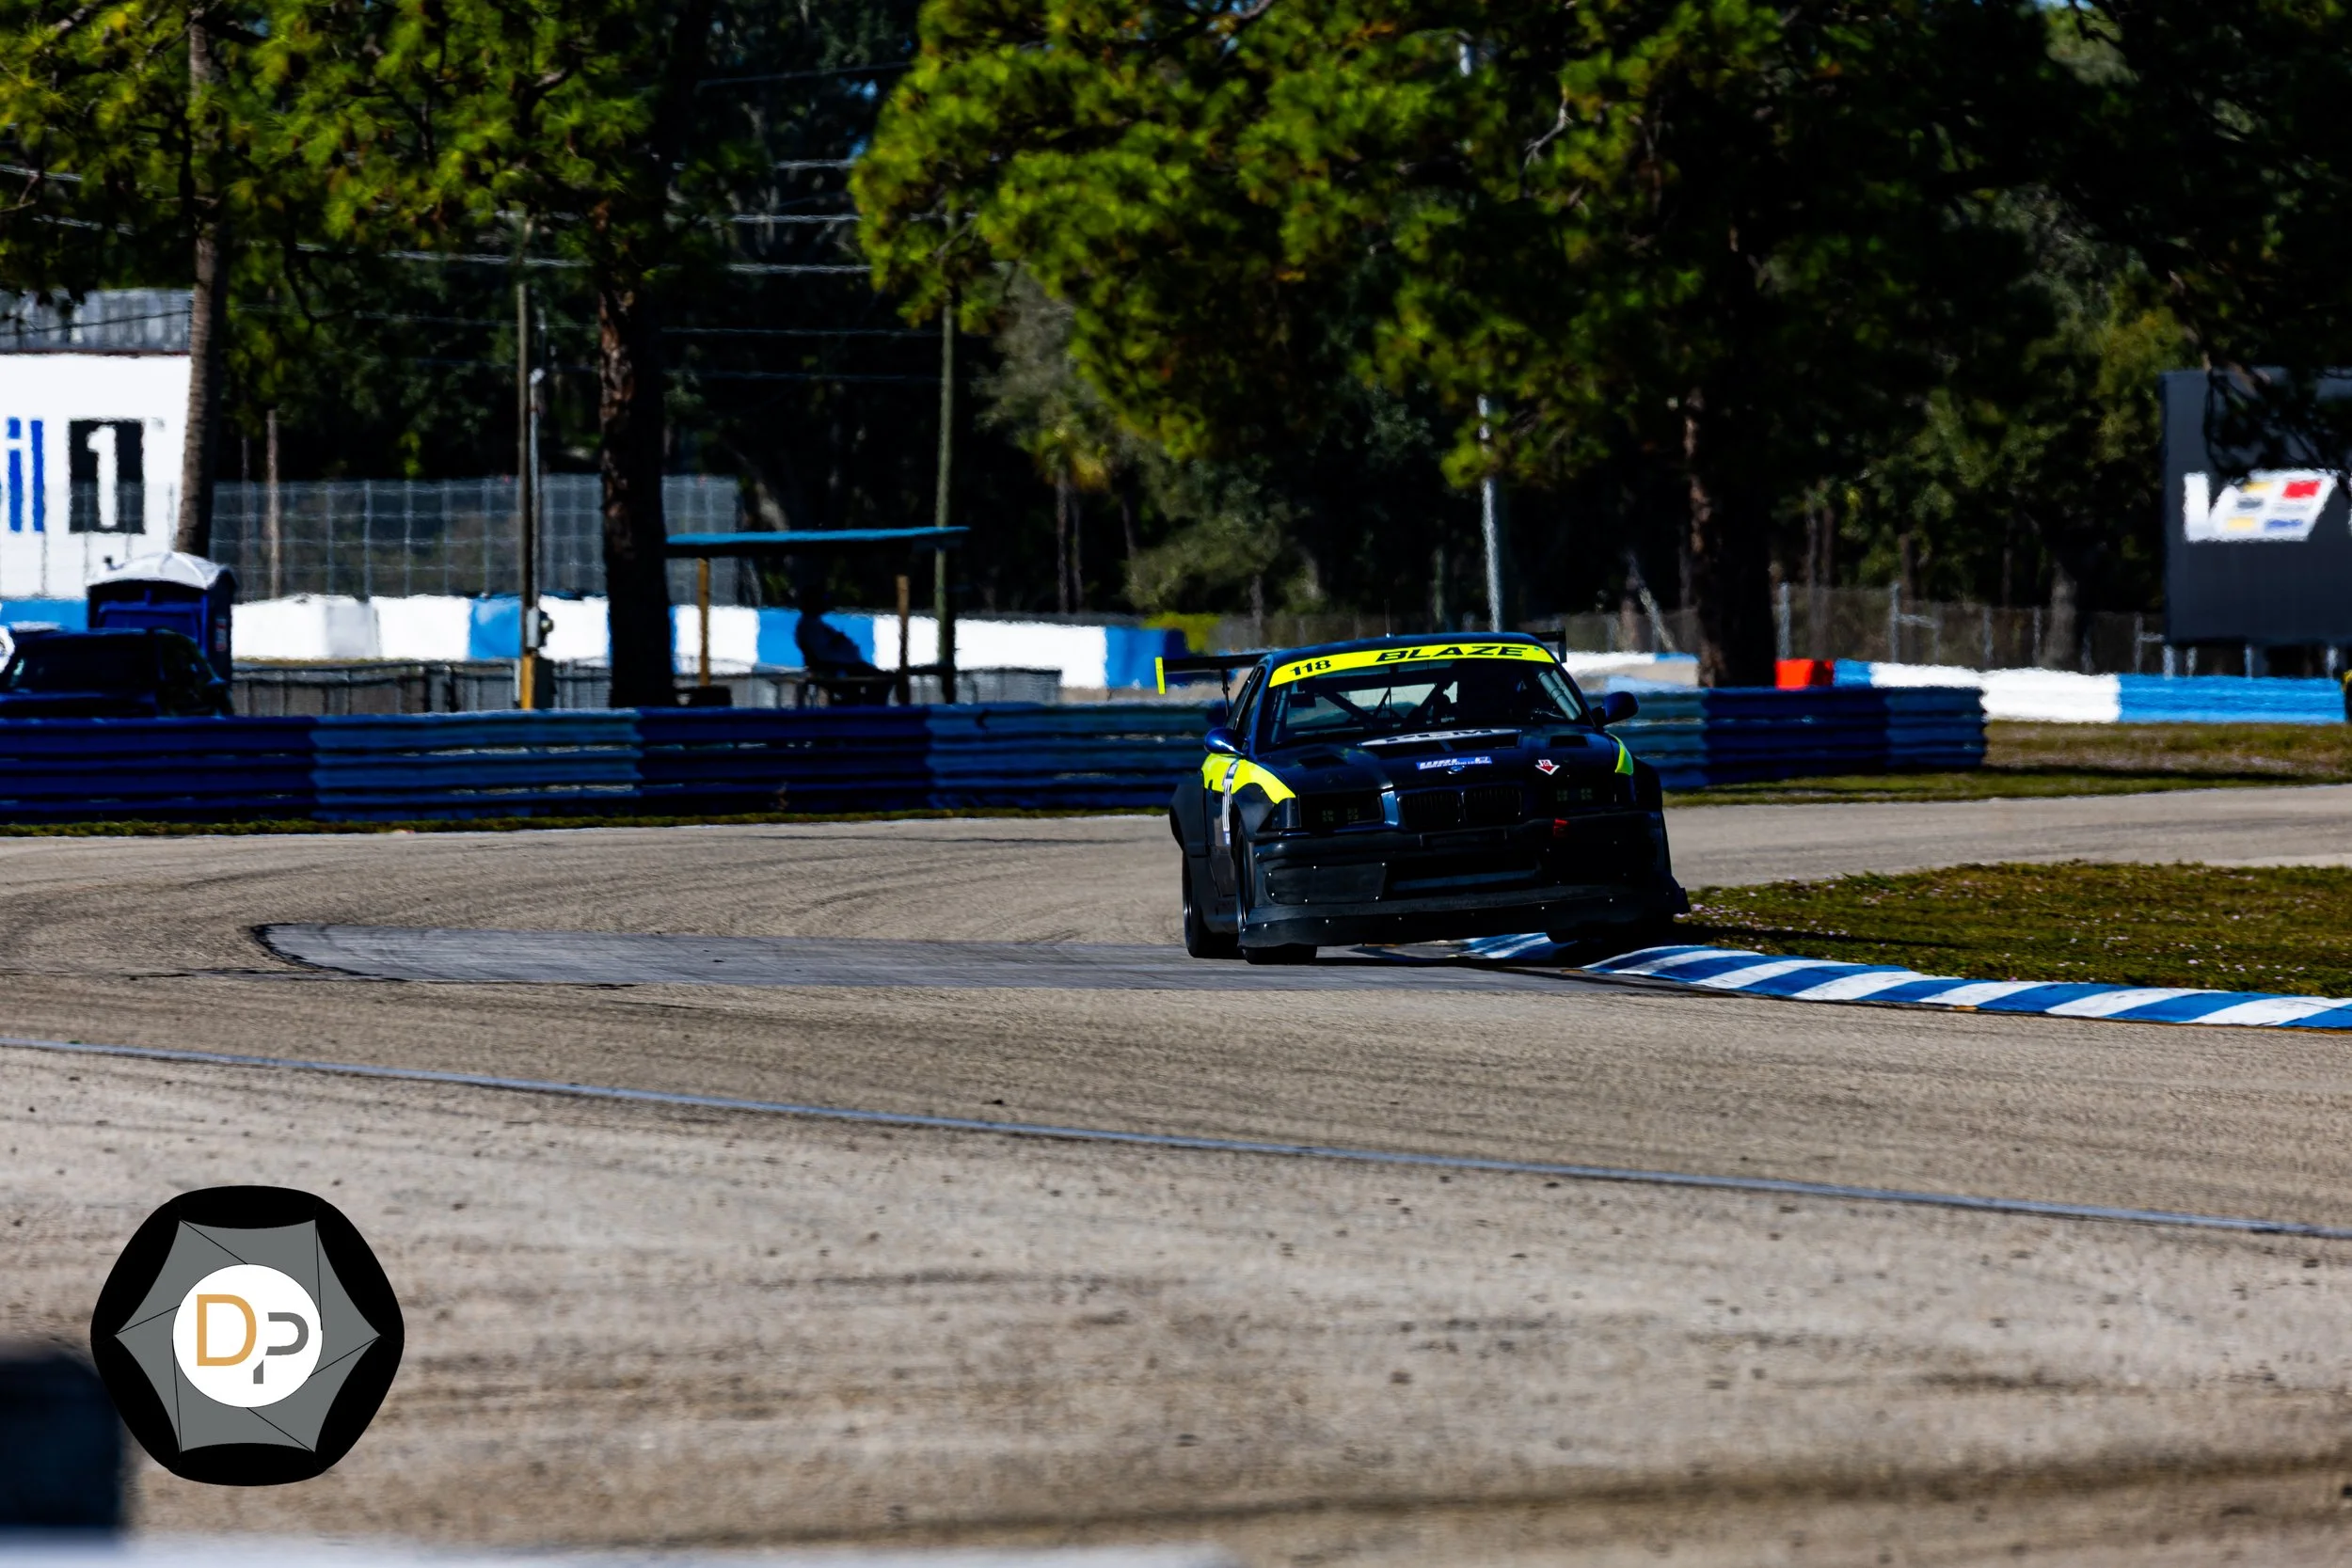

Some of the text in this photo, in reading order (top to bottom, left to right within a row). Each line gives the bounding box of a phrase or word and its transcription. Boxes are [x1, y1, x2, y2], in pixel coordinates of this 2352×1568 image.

[0, 417, 119, 532] il 1
[1289, 645, 1528, 676] 118 BLAZE
